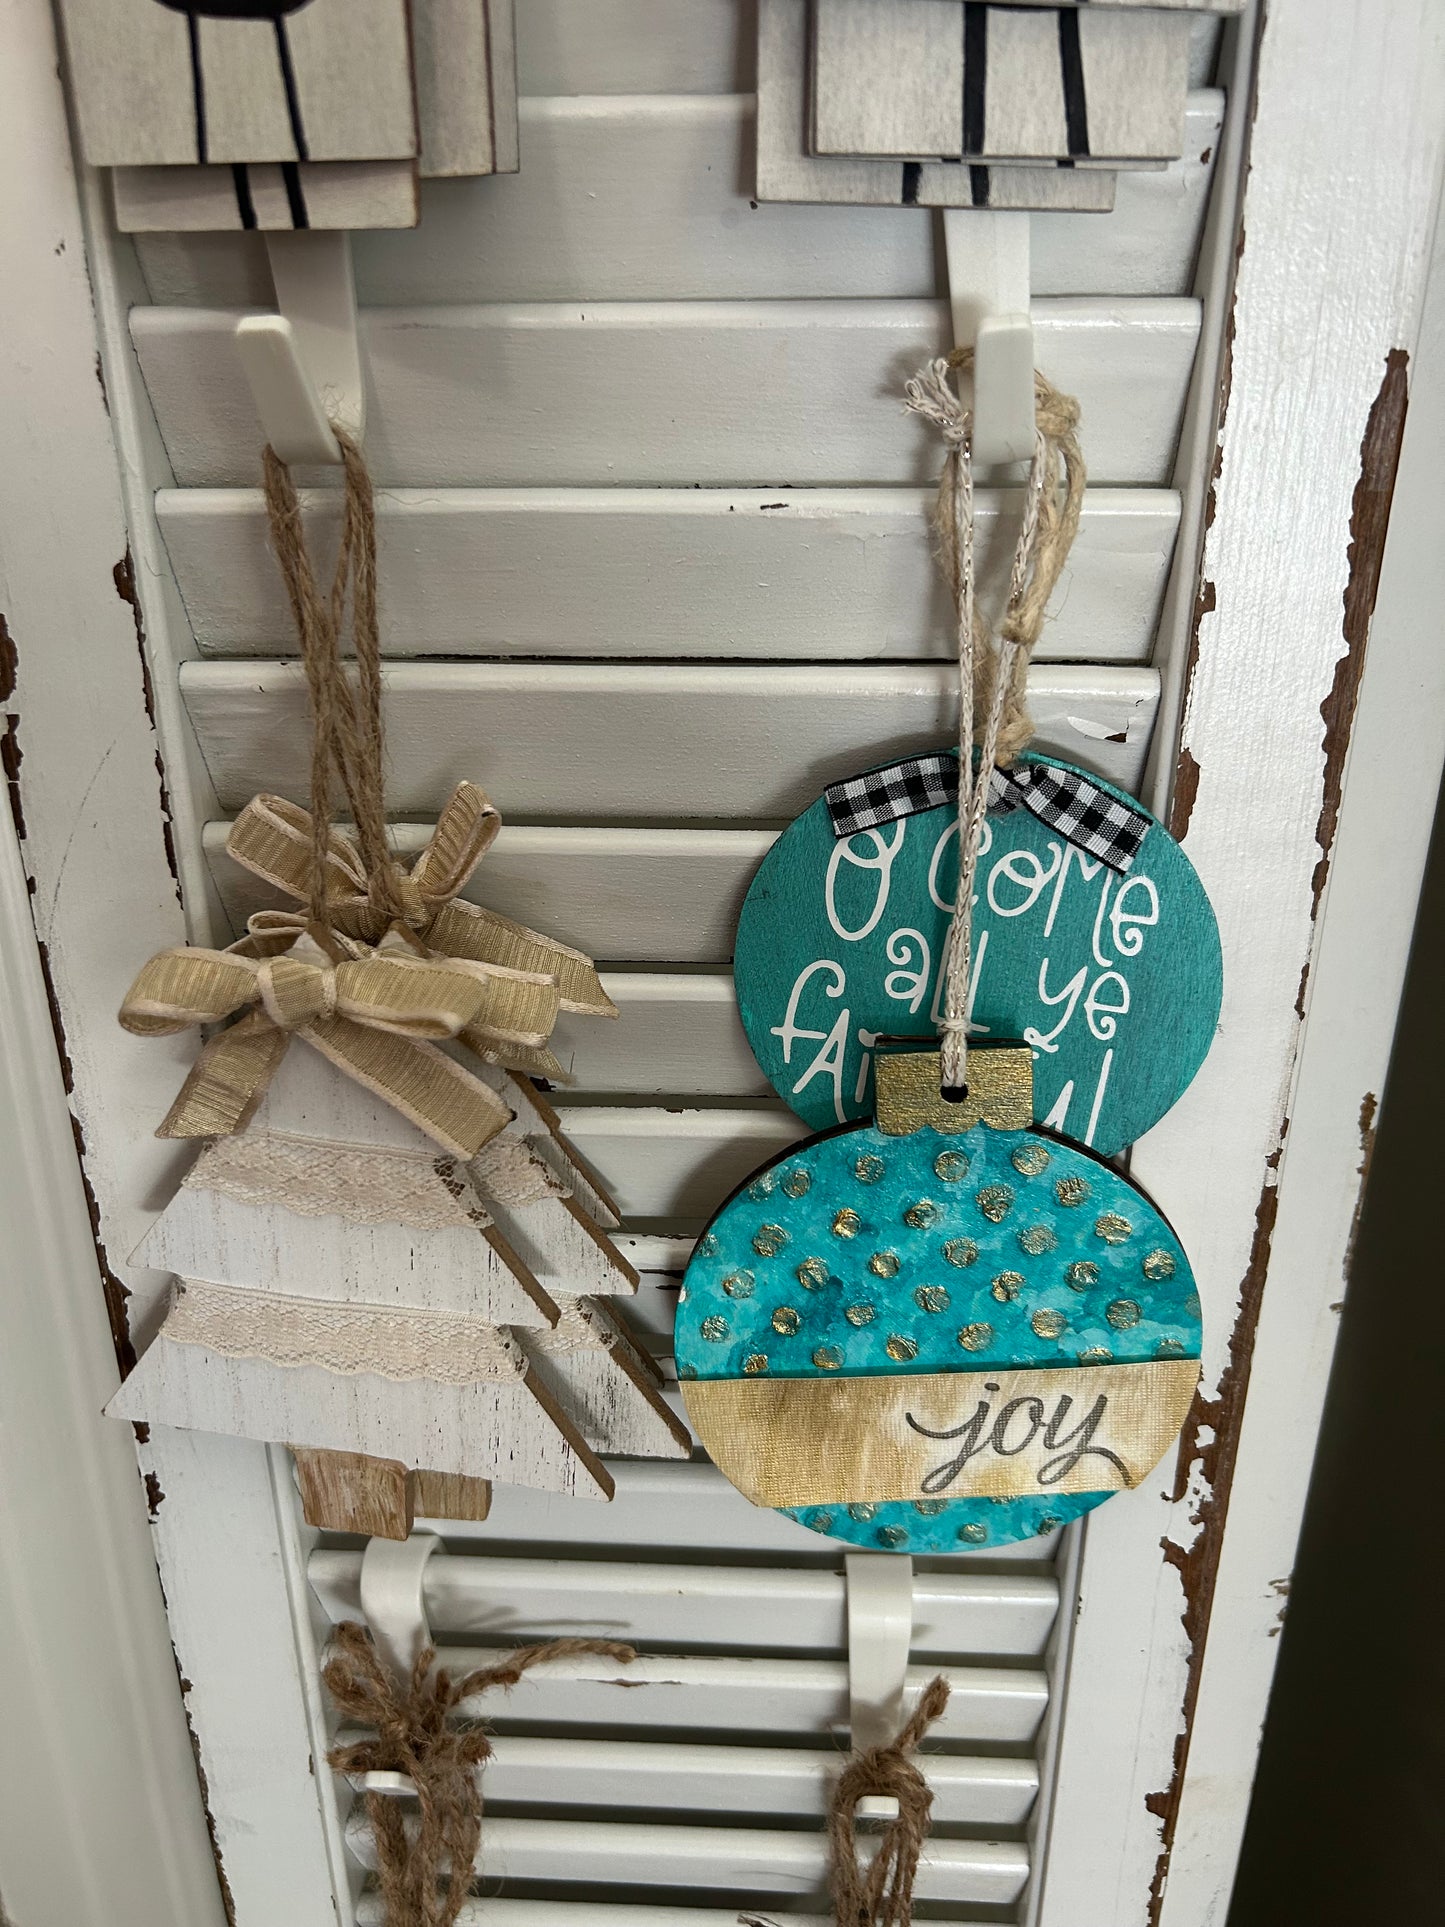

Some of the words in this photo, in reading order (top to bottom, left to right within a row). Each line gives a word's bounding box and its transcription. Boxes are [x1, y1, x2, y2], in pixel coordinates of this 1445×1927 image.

[826, 817, 905, 941] O
[1023, 957, 1130, 1053] ye
[905, 1382, 1133, 1493] joy
